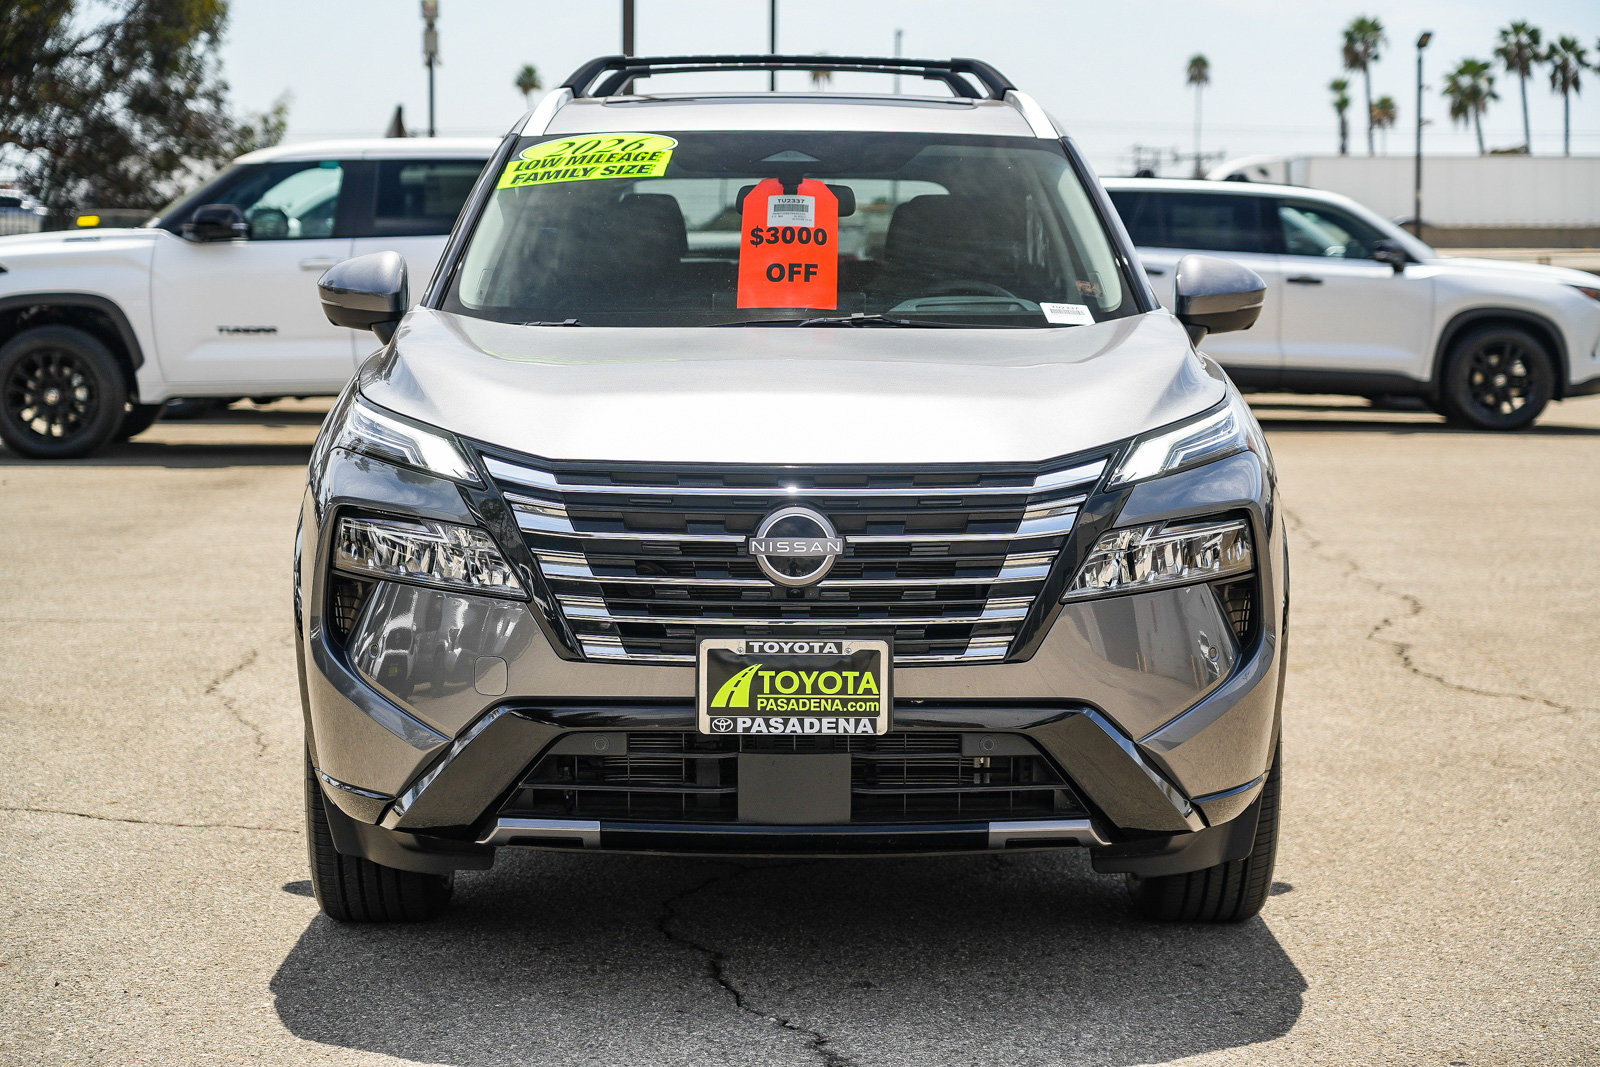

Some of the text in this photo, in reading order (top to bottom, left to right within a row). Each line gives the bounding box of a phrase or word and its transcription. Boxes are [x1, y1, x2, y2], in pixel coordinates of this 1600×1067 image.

[545, 137, 655, 158] 2026
[513, 151, 664, 172] LOW MILEAGE
[510, 164, 654, 185] FAMILY SIZE
[750, 225, 827, 248] $3000
[766, 263, 818, 282] OFF
[751, 541, 841, 553] NISSAN
[749, 642, 839, 654] TOYOTA
[757, 671, 879, 695] TOYOTA
[757, 699, 880, 712] PASADENA.com
[736, 717, 874, 734] PASADENA
